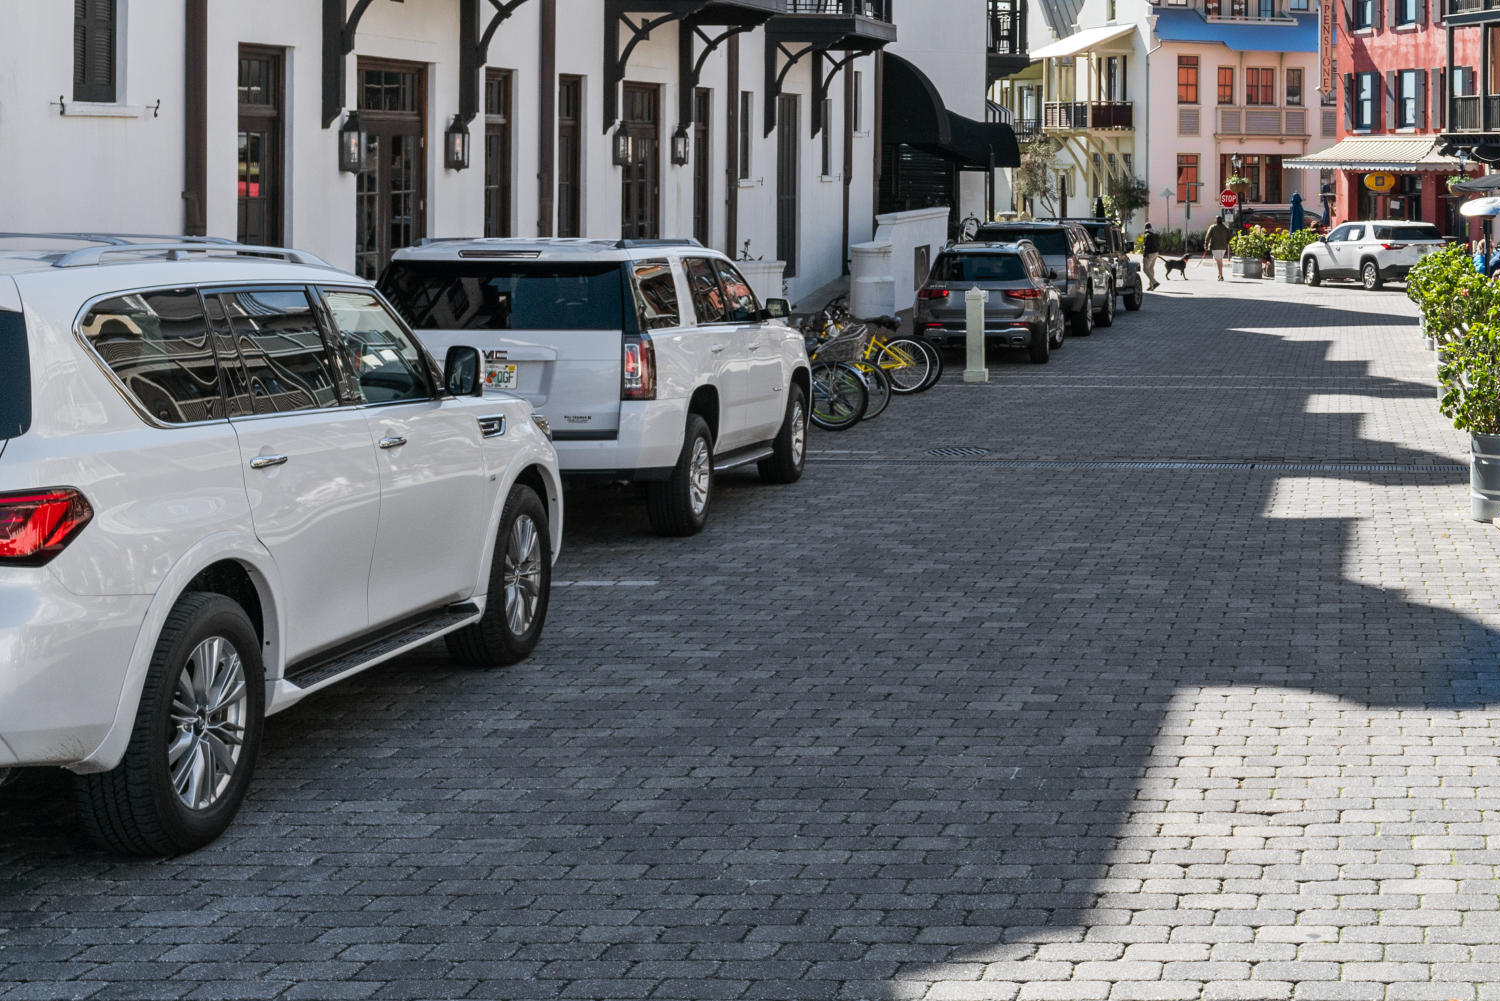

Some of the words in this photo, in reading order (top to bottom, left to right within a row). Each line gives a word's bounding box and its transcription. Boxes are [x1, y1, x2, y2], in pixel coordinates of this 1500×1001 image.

[1322, 4, 1331, 88] PENSIONE
[1221, 194, 1237, 203] STOP
[482, 350, 508, 360] MC
